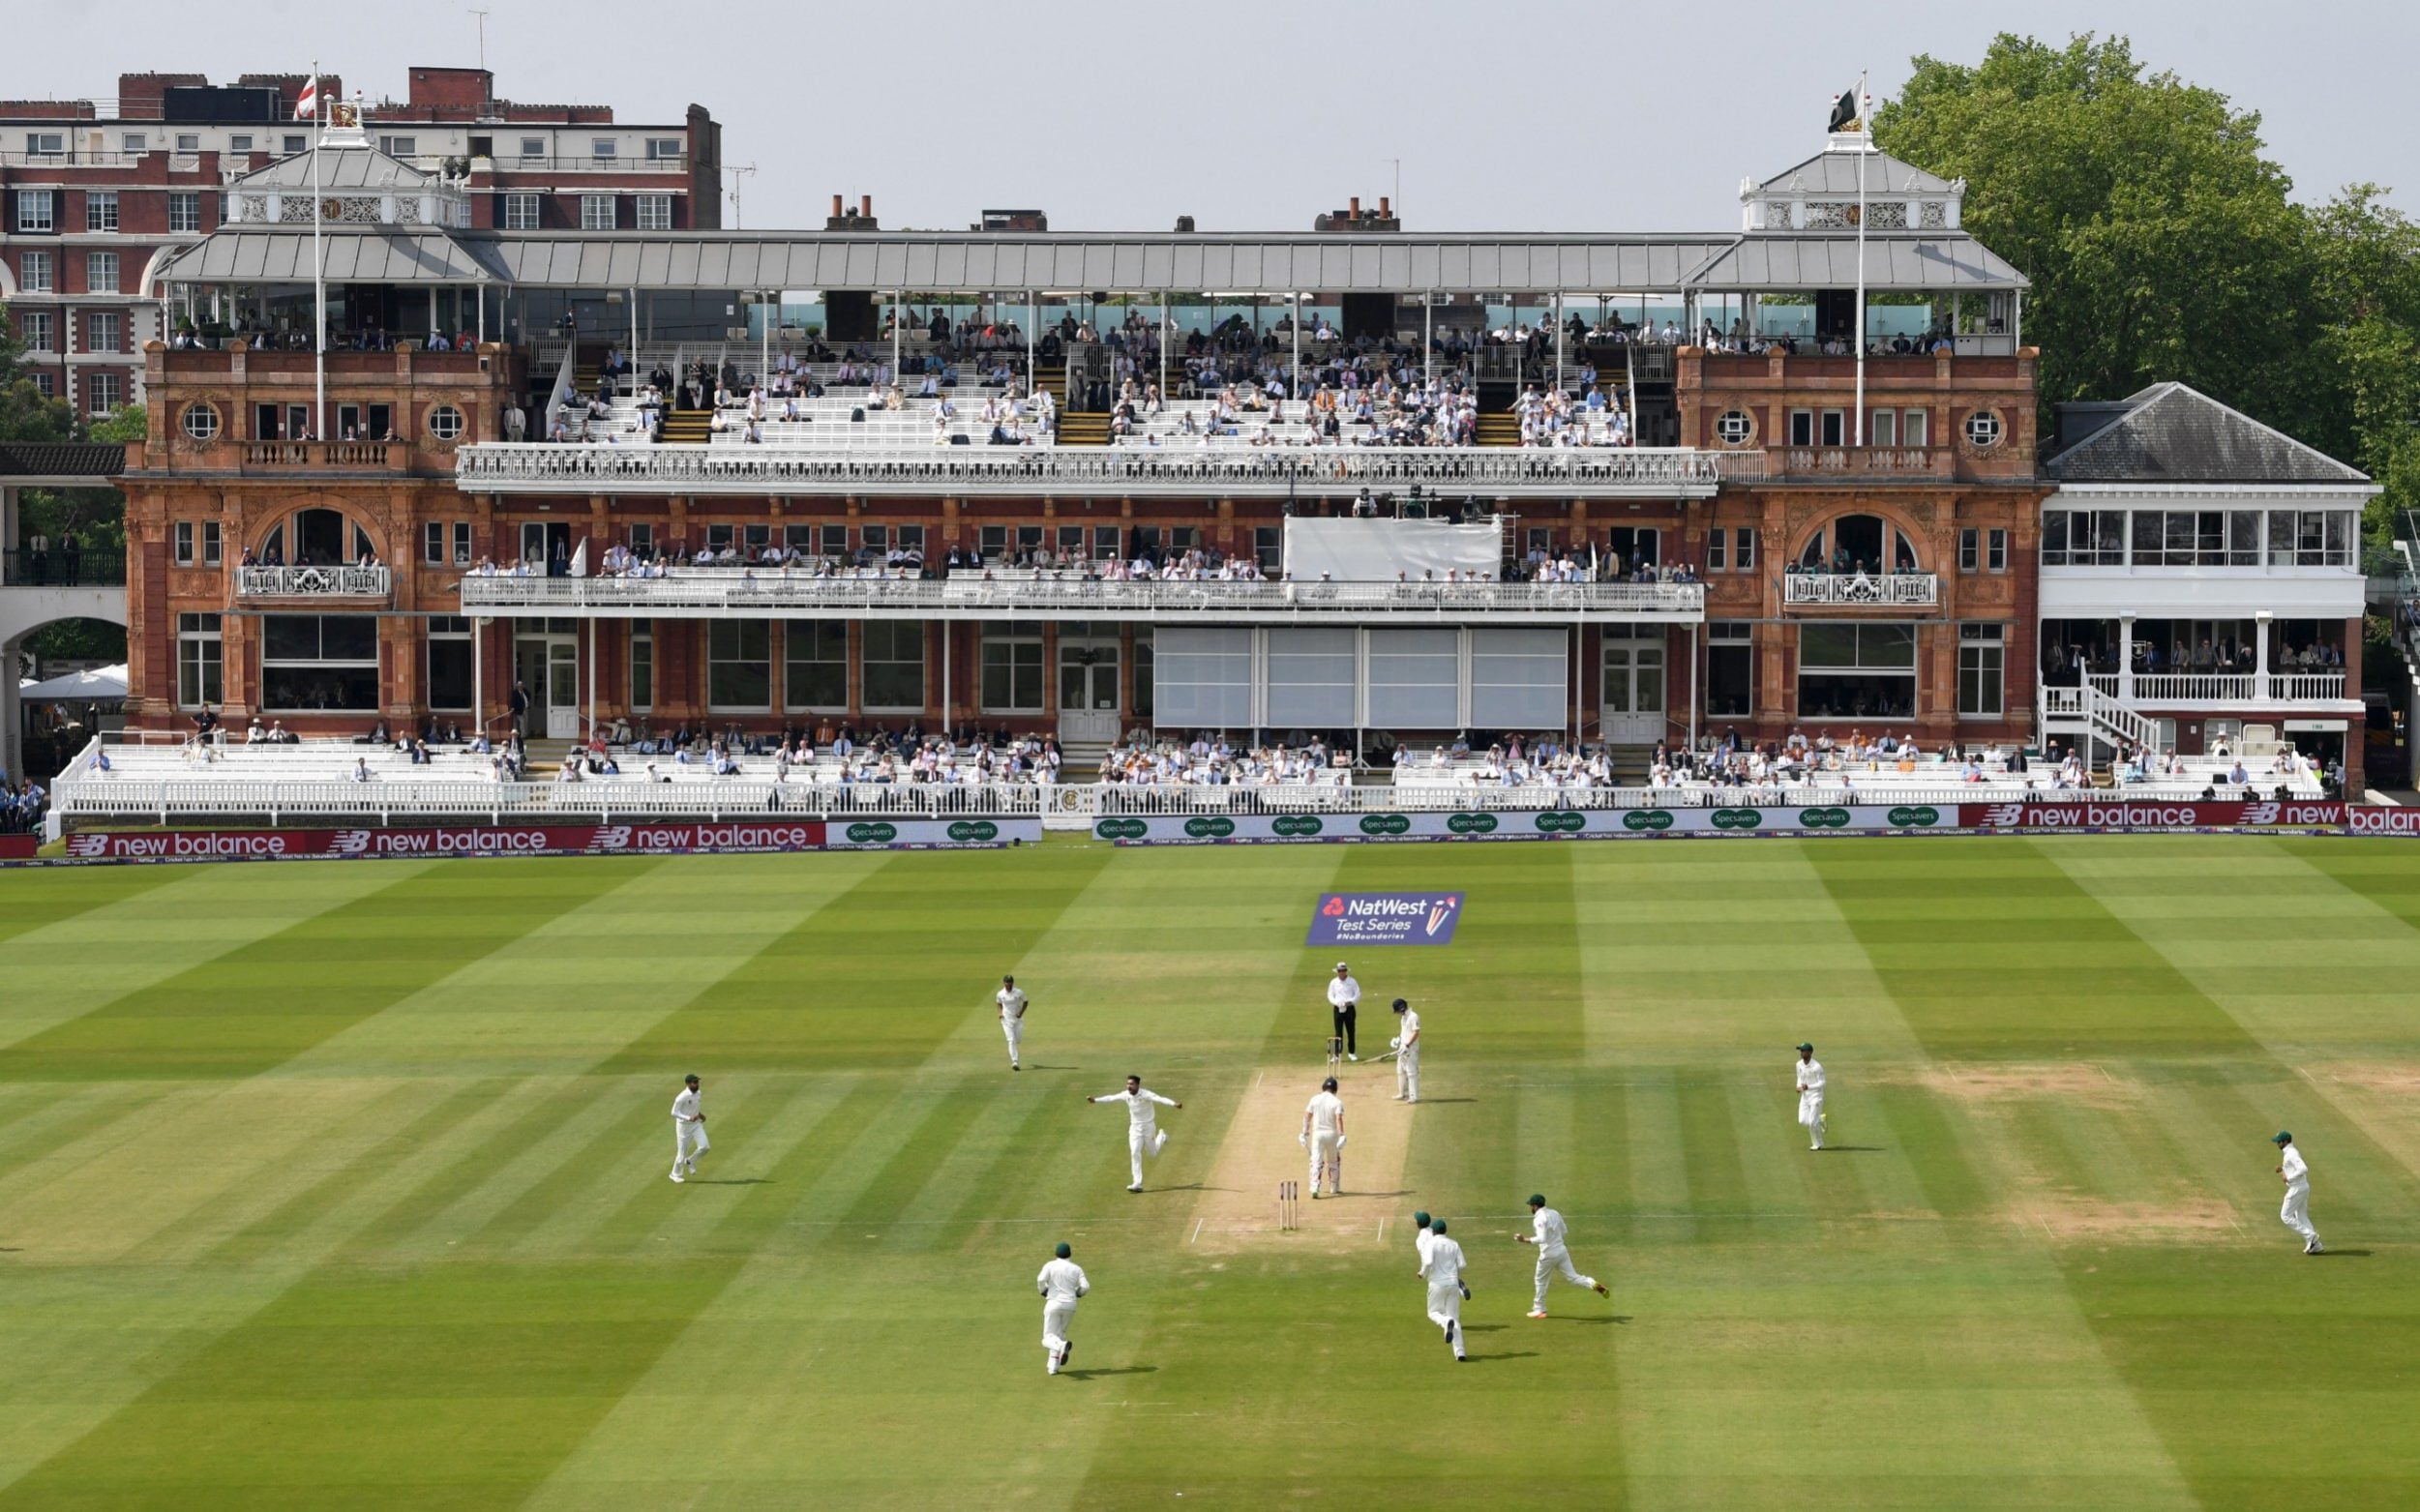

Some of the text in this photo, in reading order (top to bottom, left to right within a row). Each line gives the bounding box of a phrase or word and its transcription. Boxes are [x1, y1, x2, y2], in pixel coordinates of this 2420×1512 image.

[2029, 809, 2081, 825] new
[2088, 804, 2196, 825] balance
[2287, 807, 2340, 823] new
[1364, 819, 1405, 828] Specsavers
[1451, 818, 1493, 827] Specsavers
[1539, 817, 1581, 826] Specsavers
[1628, 815, 1669, 824] Specsavers
[1101, 824, 1143, 833] Specsavers
[1189, 822, 1231, 831] Specsavers
[1276, 820, 1318, 829] Specsavers
[639, 830, 690, 846] new
[698, 824, 806, 845] balance
[851, 828, 892, 837] Specsavers
[114, 838, 167, 855] new
[175, 833, 284, 854] balance
[377, 835, 430, 851] new
[437, 829, 546, 850] balance
[1348, 900, 1427, 915] NatWest
[1336, 918, 1412, 931] Test Series
